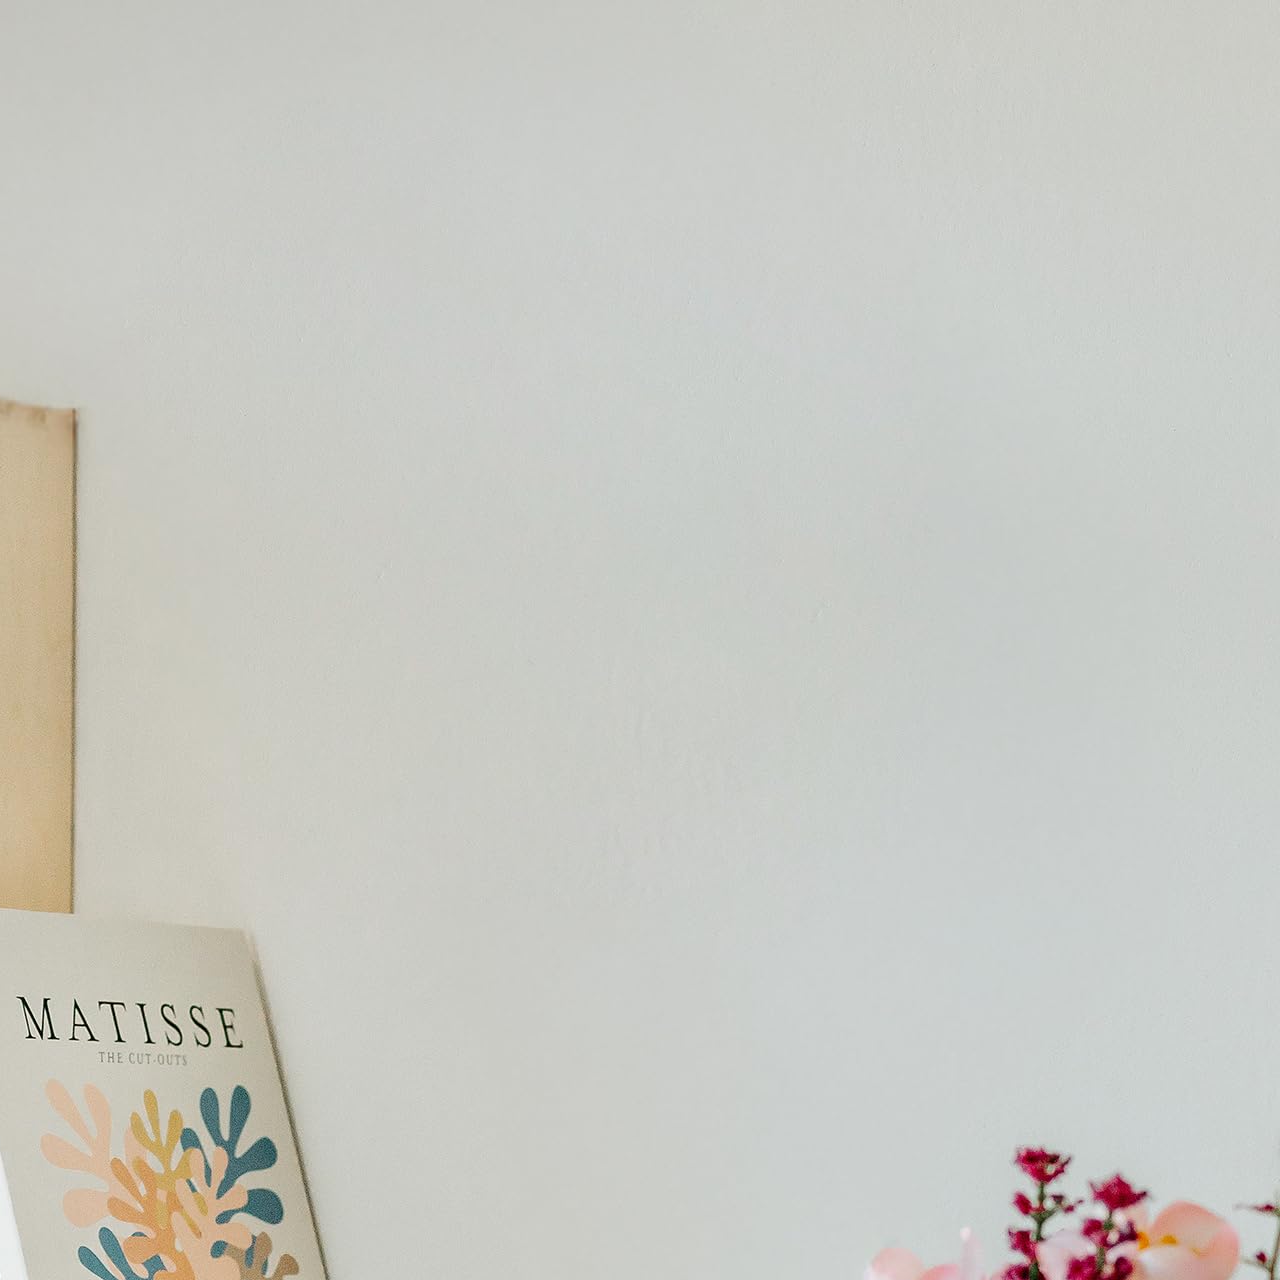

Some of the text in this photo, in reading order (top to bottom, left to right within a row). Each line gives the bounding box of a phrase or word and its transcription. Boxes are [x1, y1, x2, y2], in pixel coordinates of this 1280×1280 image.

[16, 996, 244, 1049] MATISSE
[98, 1051, 188, 1066] THE CUT-OUTS
